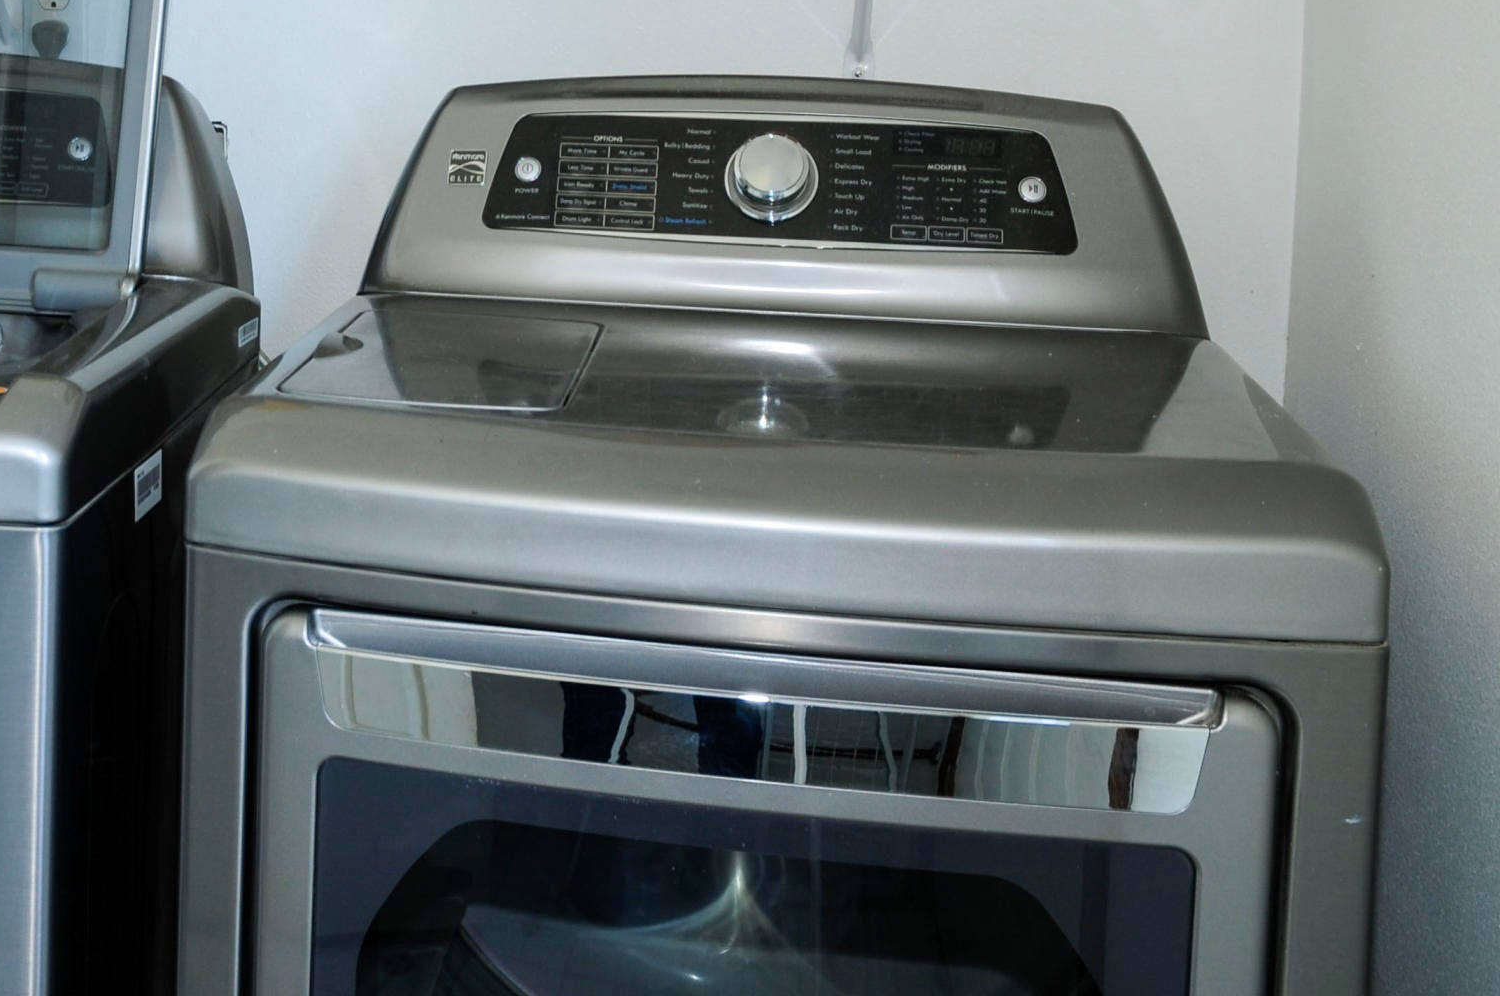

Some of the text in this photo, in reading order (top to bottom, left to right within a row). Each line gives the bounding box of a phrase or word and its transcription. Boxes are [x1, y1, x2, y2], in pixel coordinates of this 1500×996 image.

[594, 135, 623, 143] OPTIONS
[619, 149, 628, 157] My
[835, 163, 865, 171] Delicates
[927, 164, 967, 172] MODIFIERS
[449, 175, 482, 183] ELITE
[673, 172, 709, 180] Heavy Duty
[834, 178, 872, 187] Express Dry
[855, 193, 865, 201] Up
[682, 201, 708, 209] Sanitize
[846, 208, 858, 216] Dry
[833, 223, 863, 232] Rack Dry
